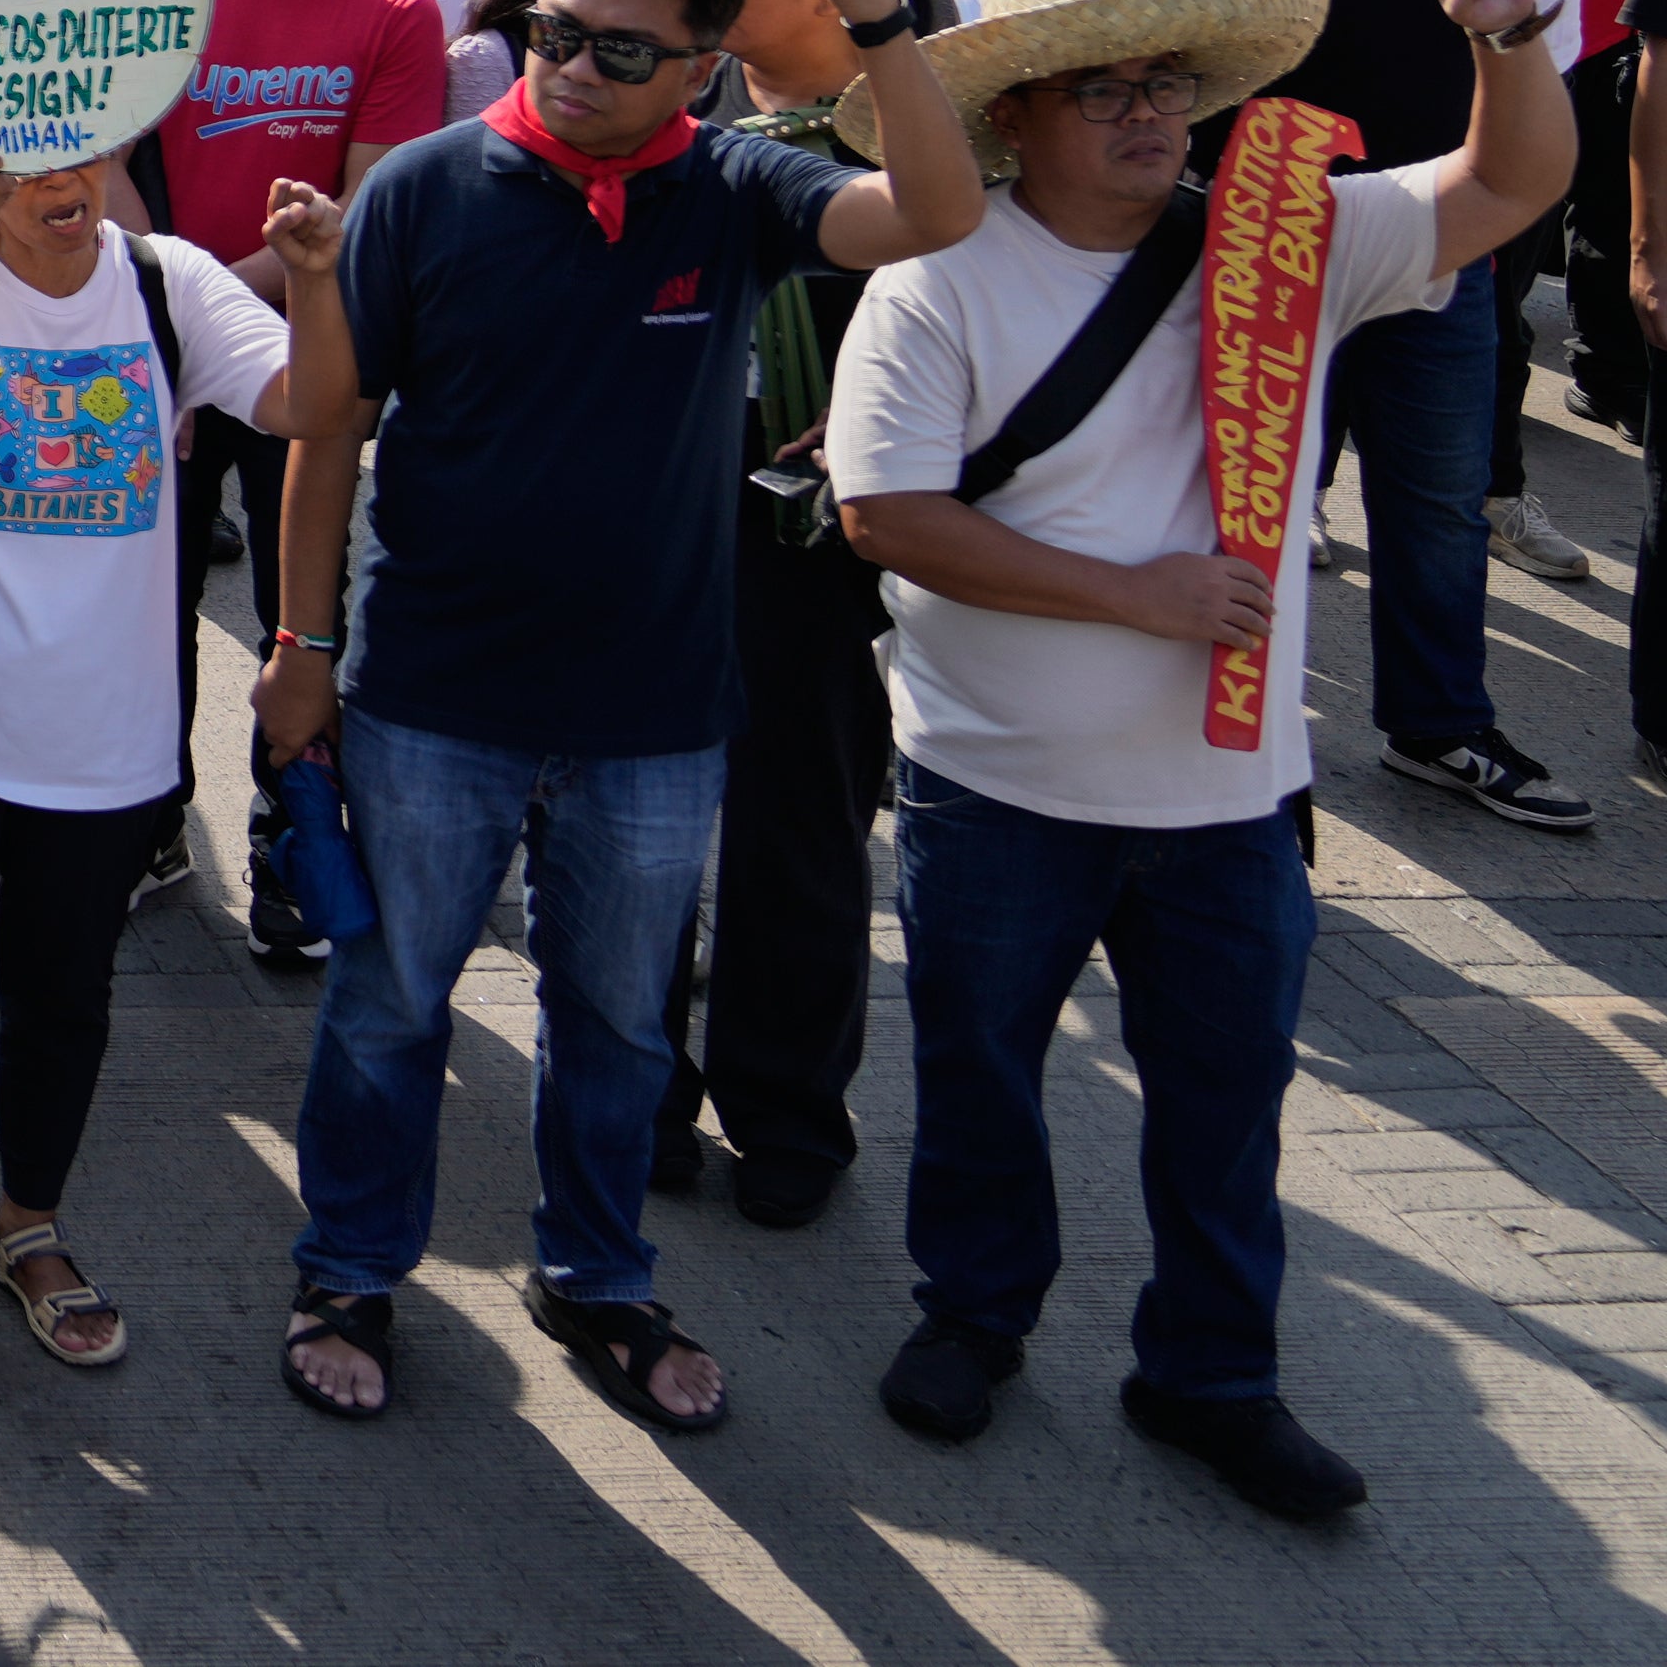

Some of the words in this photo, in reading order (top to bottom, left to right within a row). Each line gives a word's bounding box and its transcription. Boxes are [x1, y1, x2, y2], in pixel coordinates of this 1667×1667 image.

[267, 120, 299, 139] Copy
[302, 119, 338, 138] Paper
[41, 389, 63, 418] I
[1214, 328, 1251, 411] ANG
[1220, 414, 1248, 539] ITAYO
[1246, 329, 1306, 550] COUNCIL
